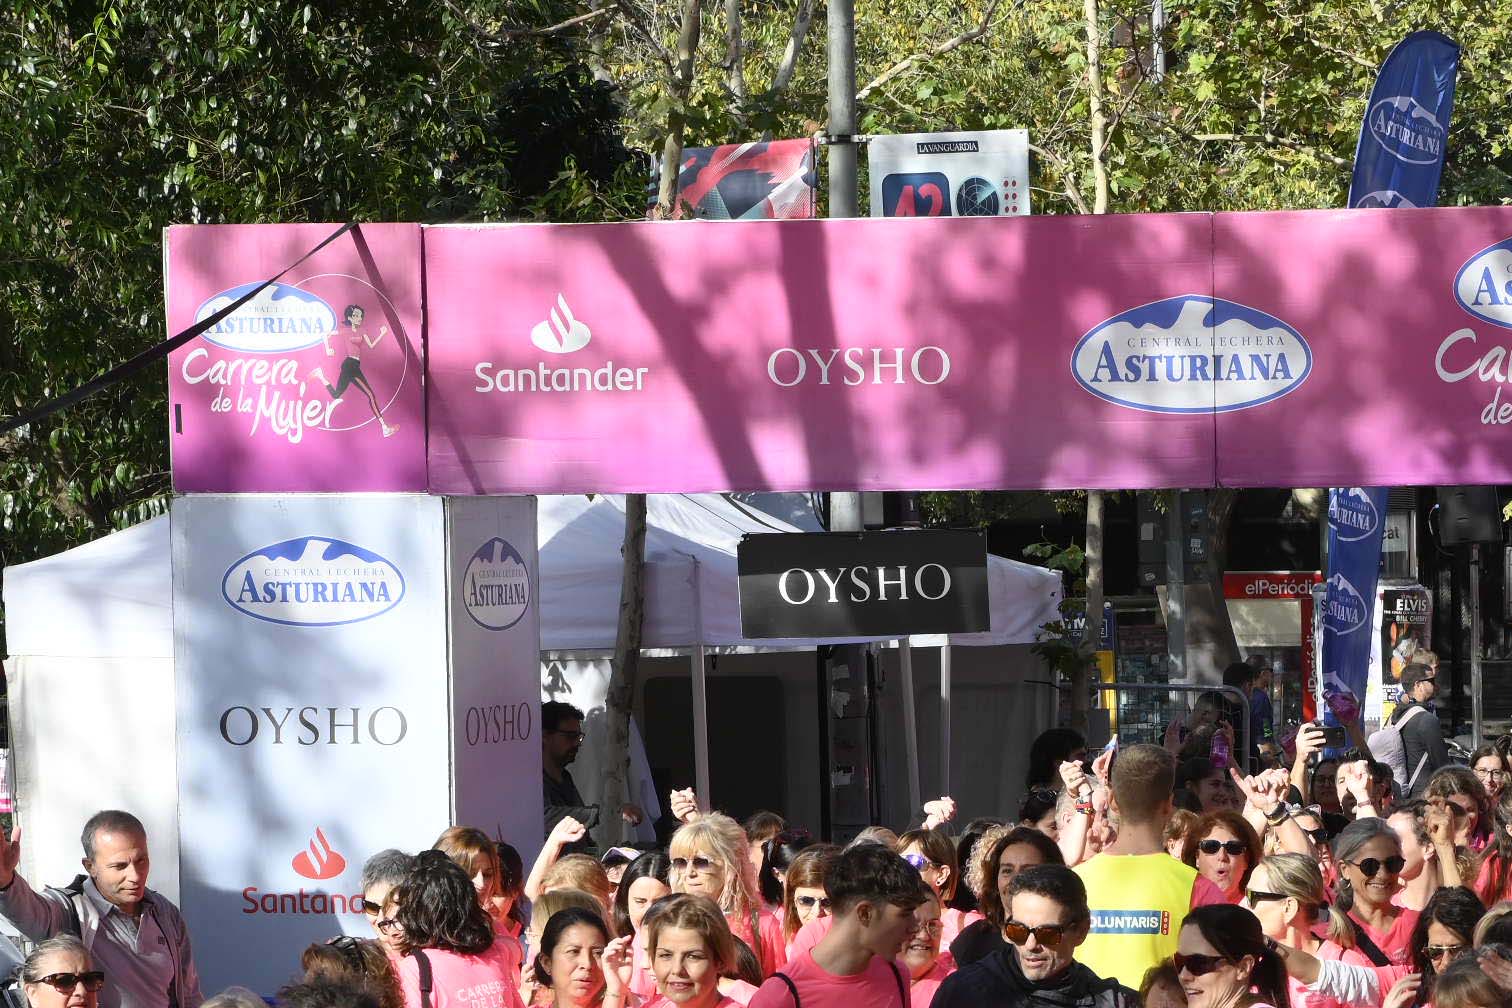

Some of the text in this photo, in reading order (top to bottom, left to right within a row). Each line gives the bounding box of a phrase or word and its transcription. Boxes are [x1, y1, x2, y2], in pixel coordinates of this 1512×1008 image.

[1126, 335, 1285, 347] CENTRAL LECHERA
[182, 348, 301, 384] Carrera
[475, 360, 649, 393] Santander
[767, 345, 951, 386] OYSHO
[1090, 340, 1293, 383] ASTURIANA
[211, 378, 343, 444] de la Mujer
[236, 570, 392, 603] ASTURIANA
[264, 567, 385, 577] CENTRAL LECHERA
[777, 563, 952, 605] OYSHO
[1245, 579, 1313, 595] elPeriódi
[468, 574, 527, 607] ASTURIANA
[1396, 598, 1427, 612] ELVIS
[219, 705, 408, 746] OYSHO
[465, 701, 532, 746] OYSHO
[1090, 916, 1159, 929] OLUNTARIS
